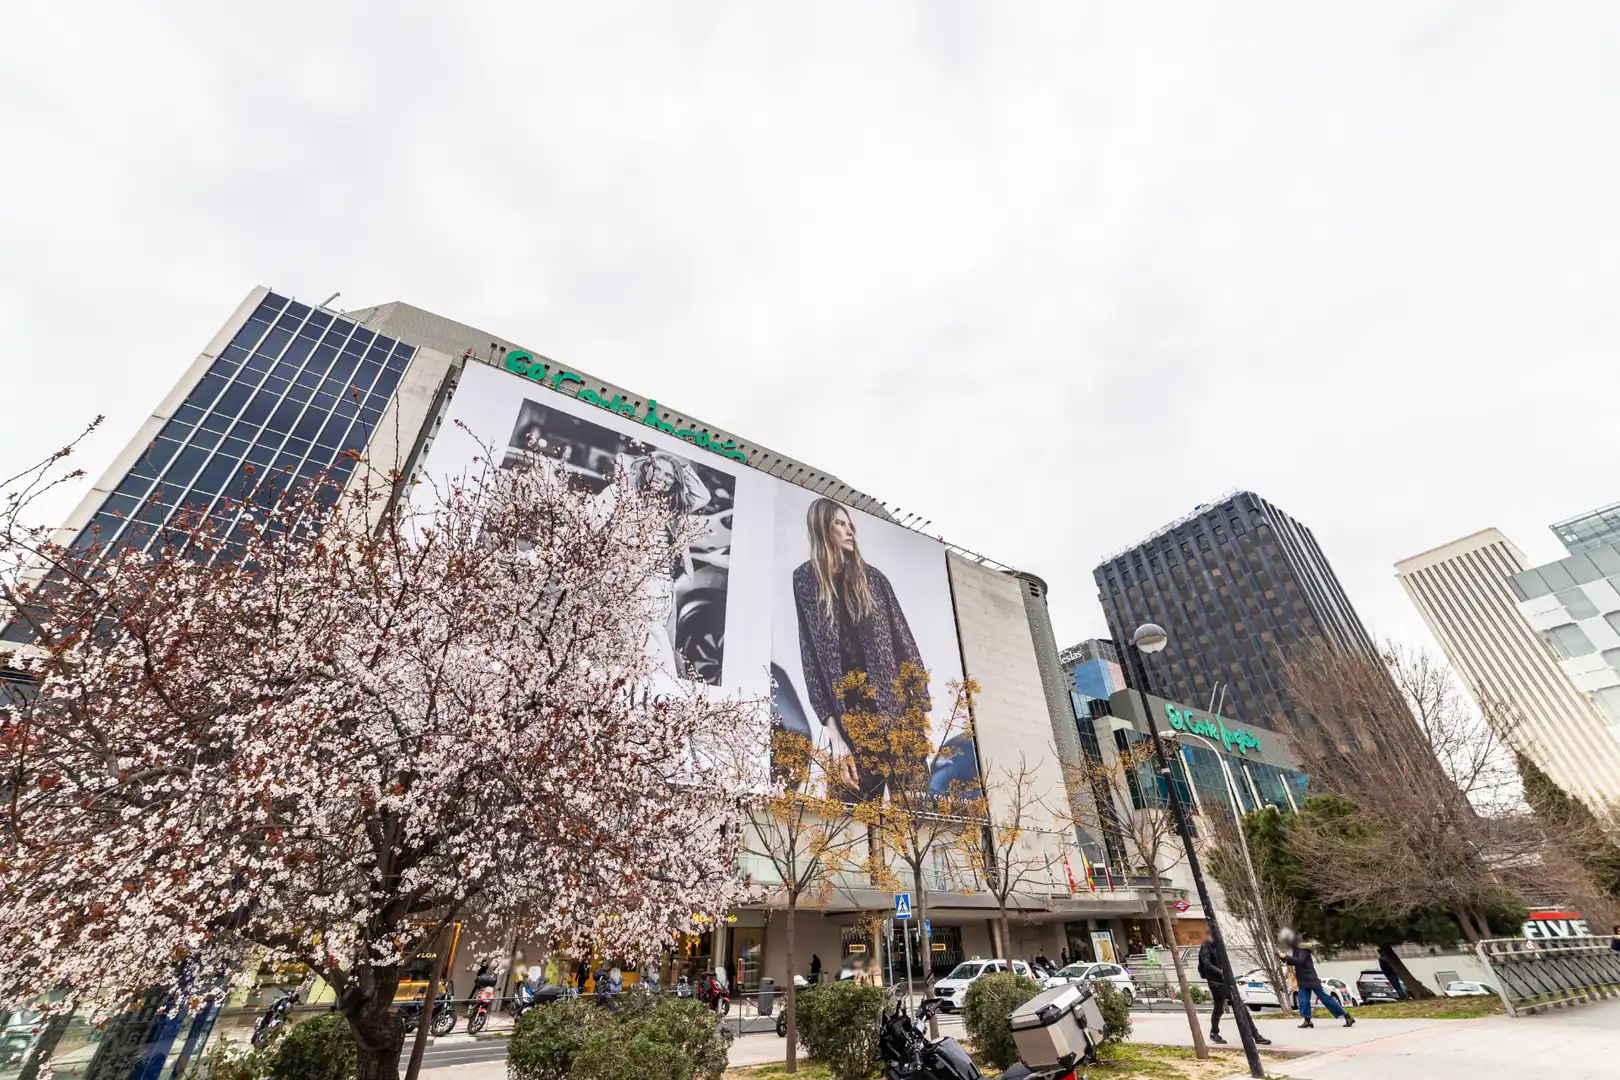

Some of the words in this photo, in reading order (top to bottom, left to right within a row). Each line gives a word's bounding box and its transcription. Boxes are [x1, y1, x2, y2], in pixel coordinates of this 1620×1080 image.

[1165, 703, 1186, 731] El
[1184, 709, 1220, 740] Corte
[1215, 713, 1261, 755] Inglés
[1521, 920, 1594, 939] FIVE
